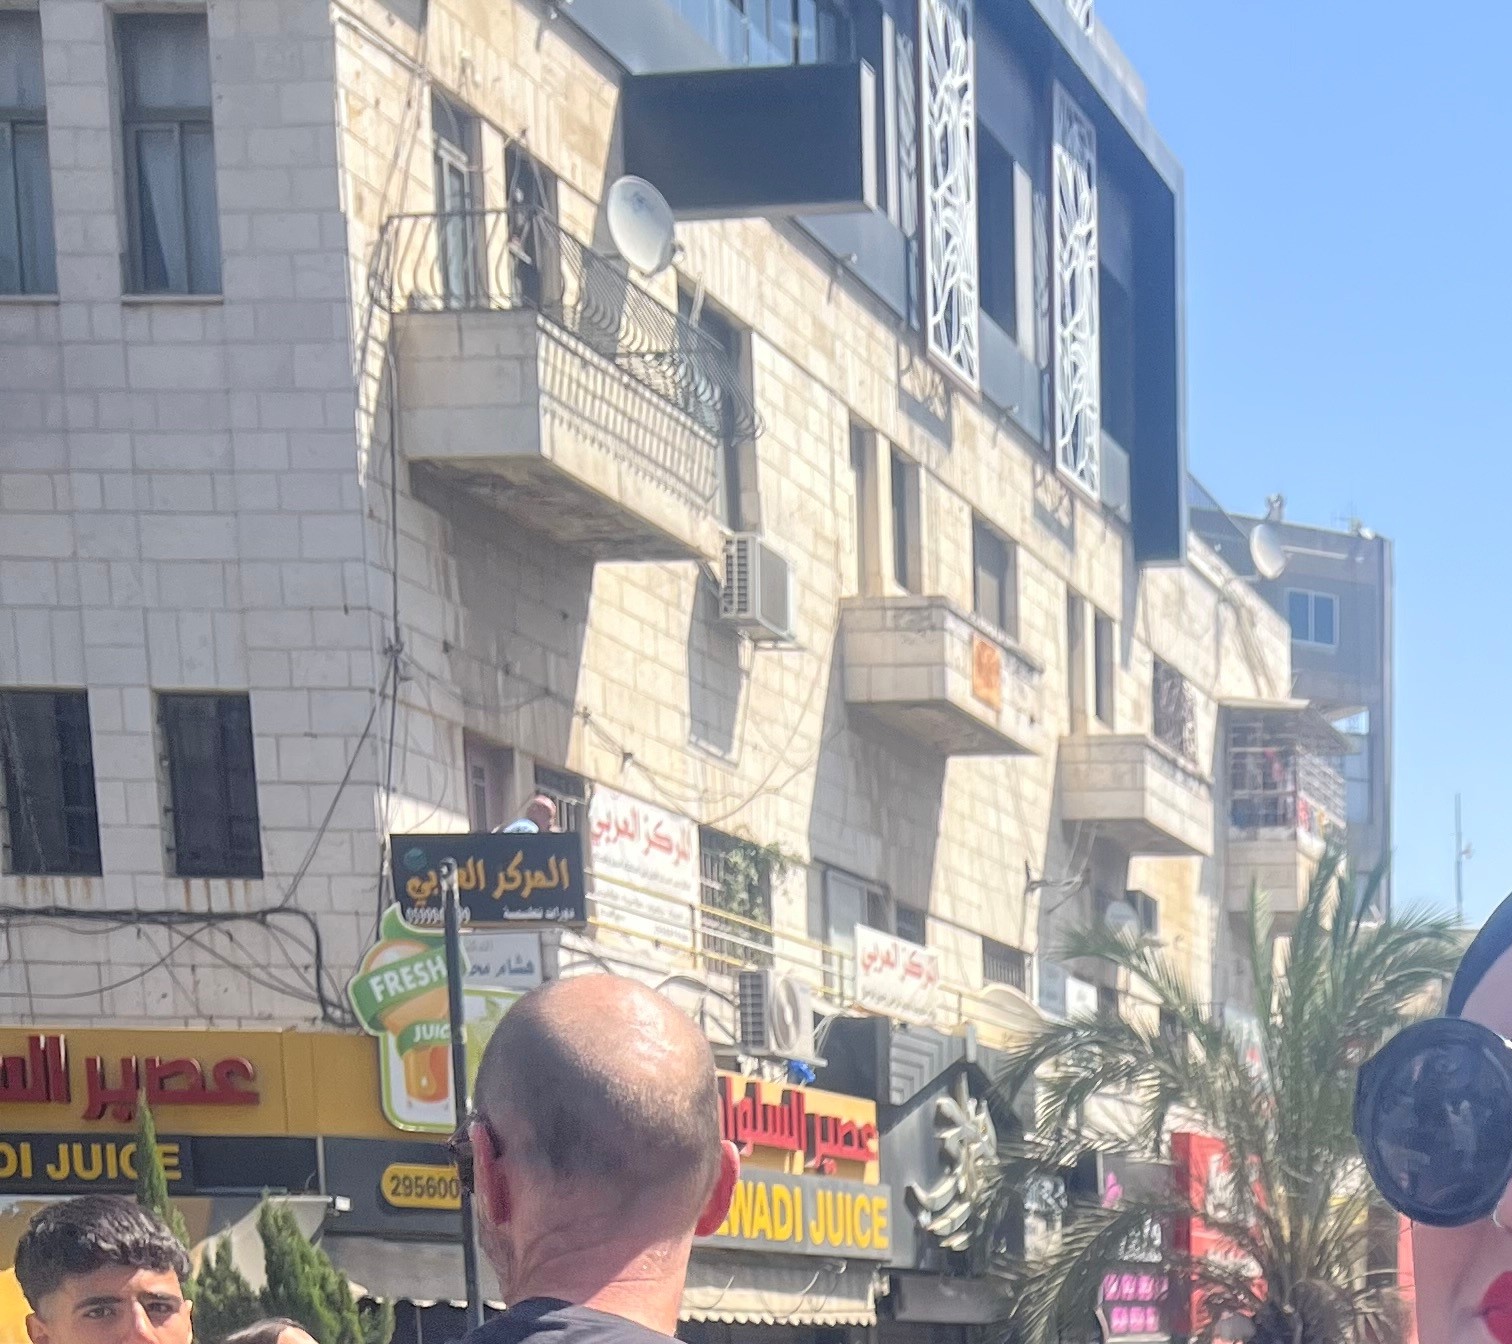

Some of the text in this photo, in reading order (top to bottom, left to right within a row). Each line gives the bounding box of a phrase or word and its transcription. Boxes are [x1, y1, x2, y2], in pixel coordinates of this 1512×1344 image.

[369, 955, 448, 1003] FRESH
[412, 1023, 452, 1043] JUIC
[81, 1054, 260, 1122] عصير
[390, 1173, 461, 1200] 295600
[808, 1188, 890, 1250] JUICE
